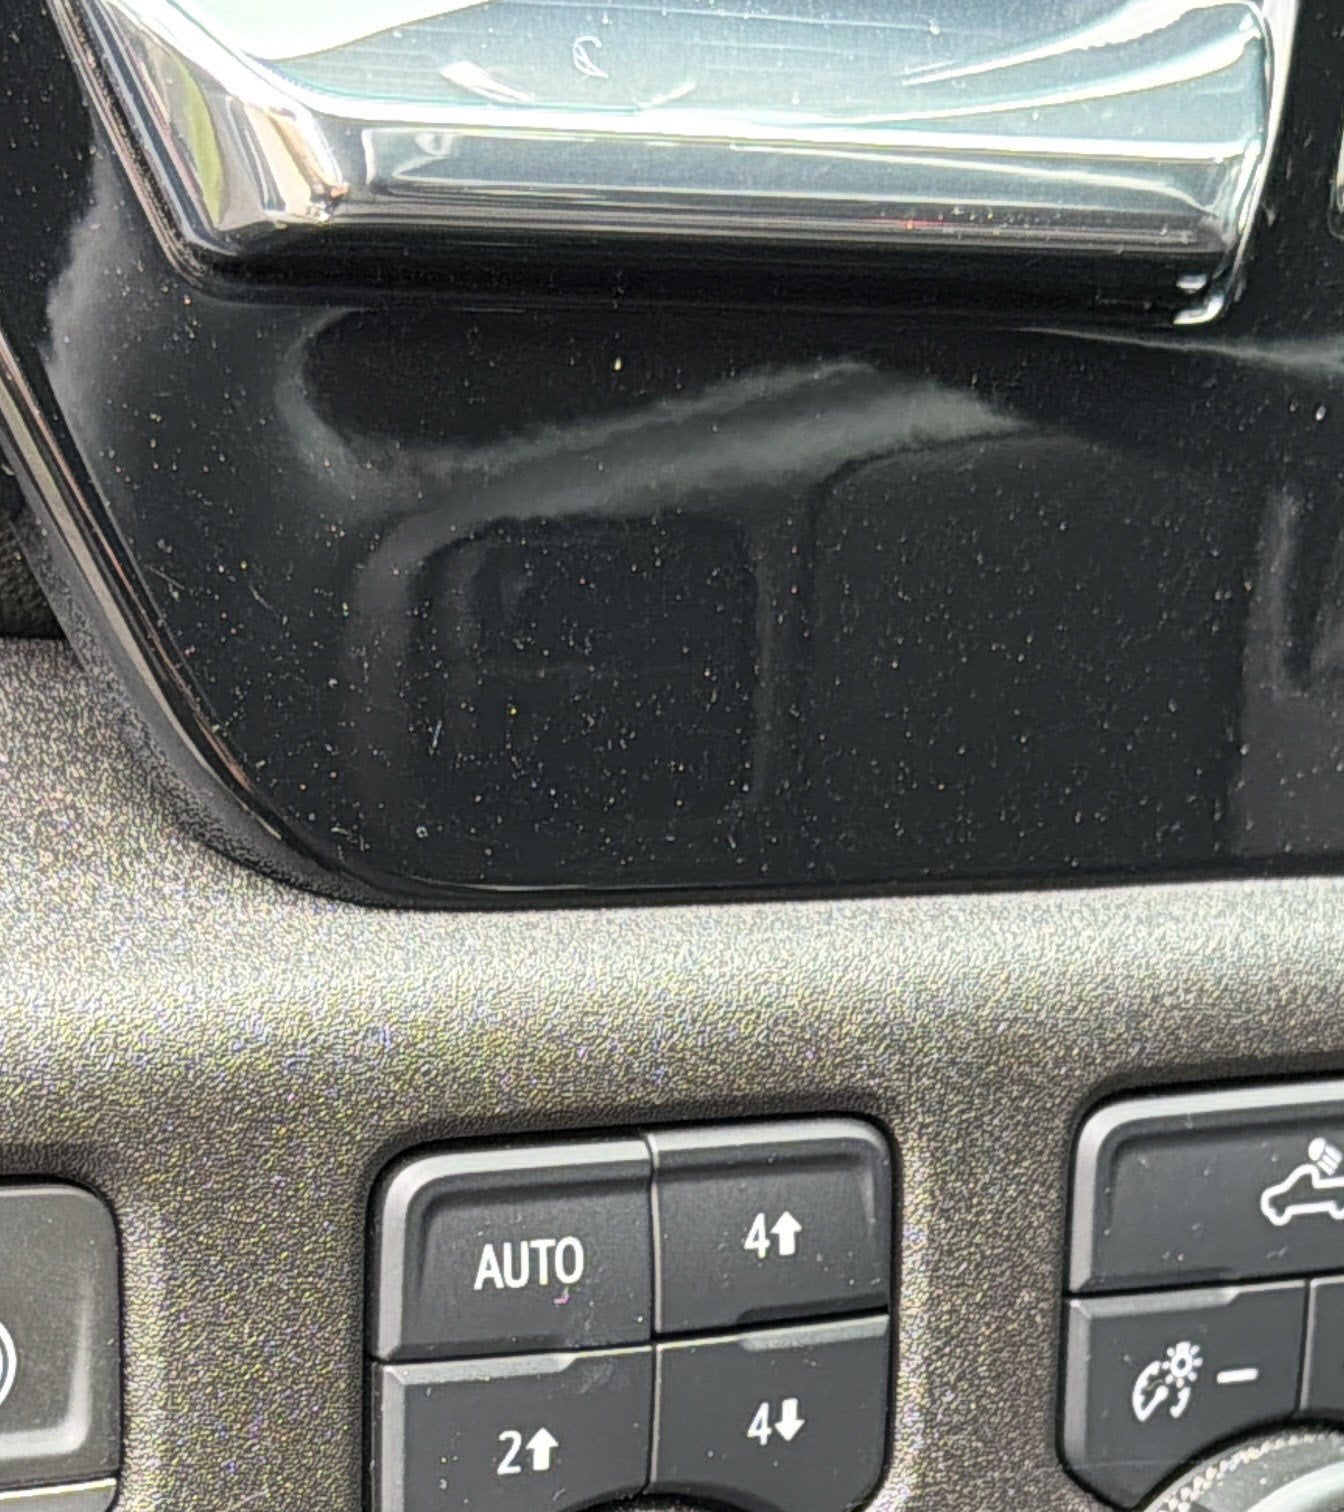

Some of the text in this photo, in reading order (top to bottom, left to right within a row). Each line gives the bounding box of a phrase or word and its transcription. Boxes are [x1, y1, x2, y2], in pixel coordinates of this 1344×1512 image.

[743, 1212, 770, 1259] 4
[473, 1235, 585, 1291] AUTO
[746, 1402, 772, 1446] 4
[496, 1430, 522, 1476] 2
